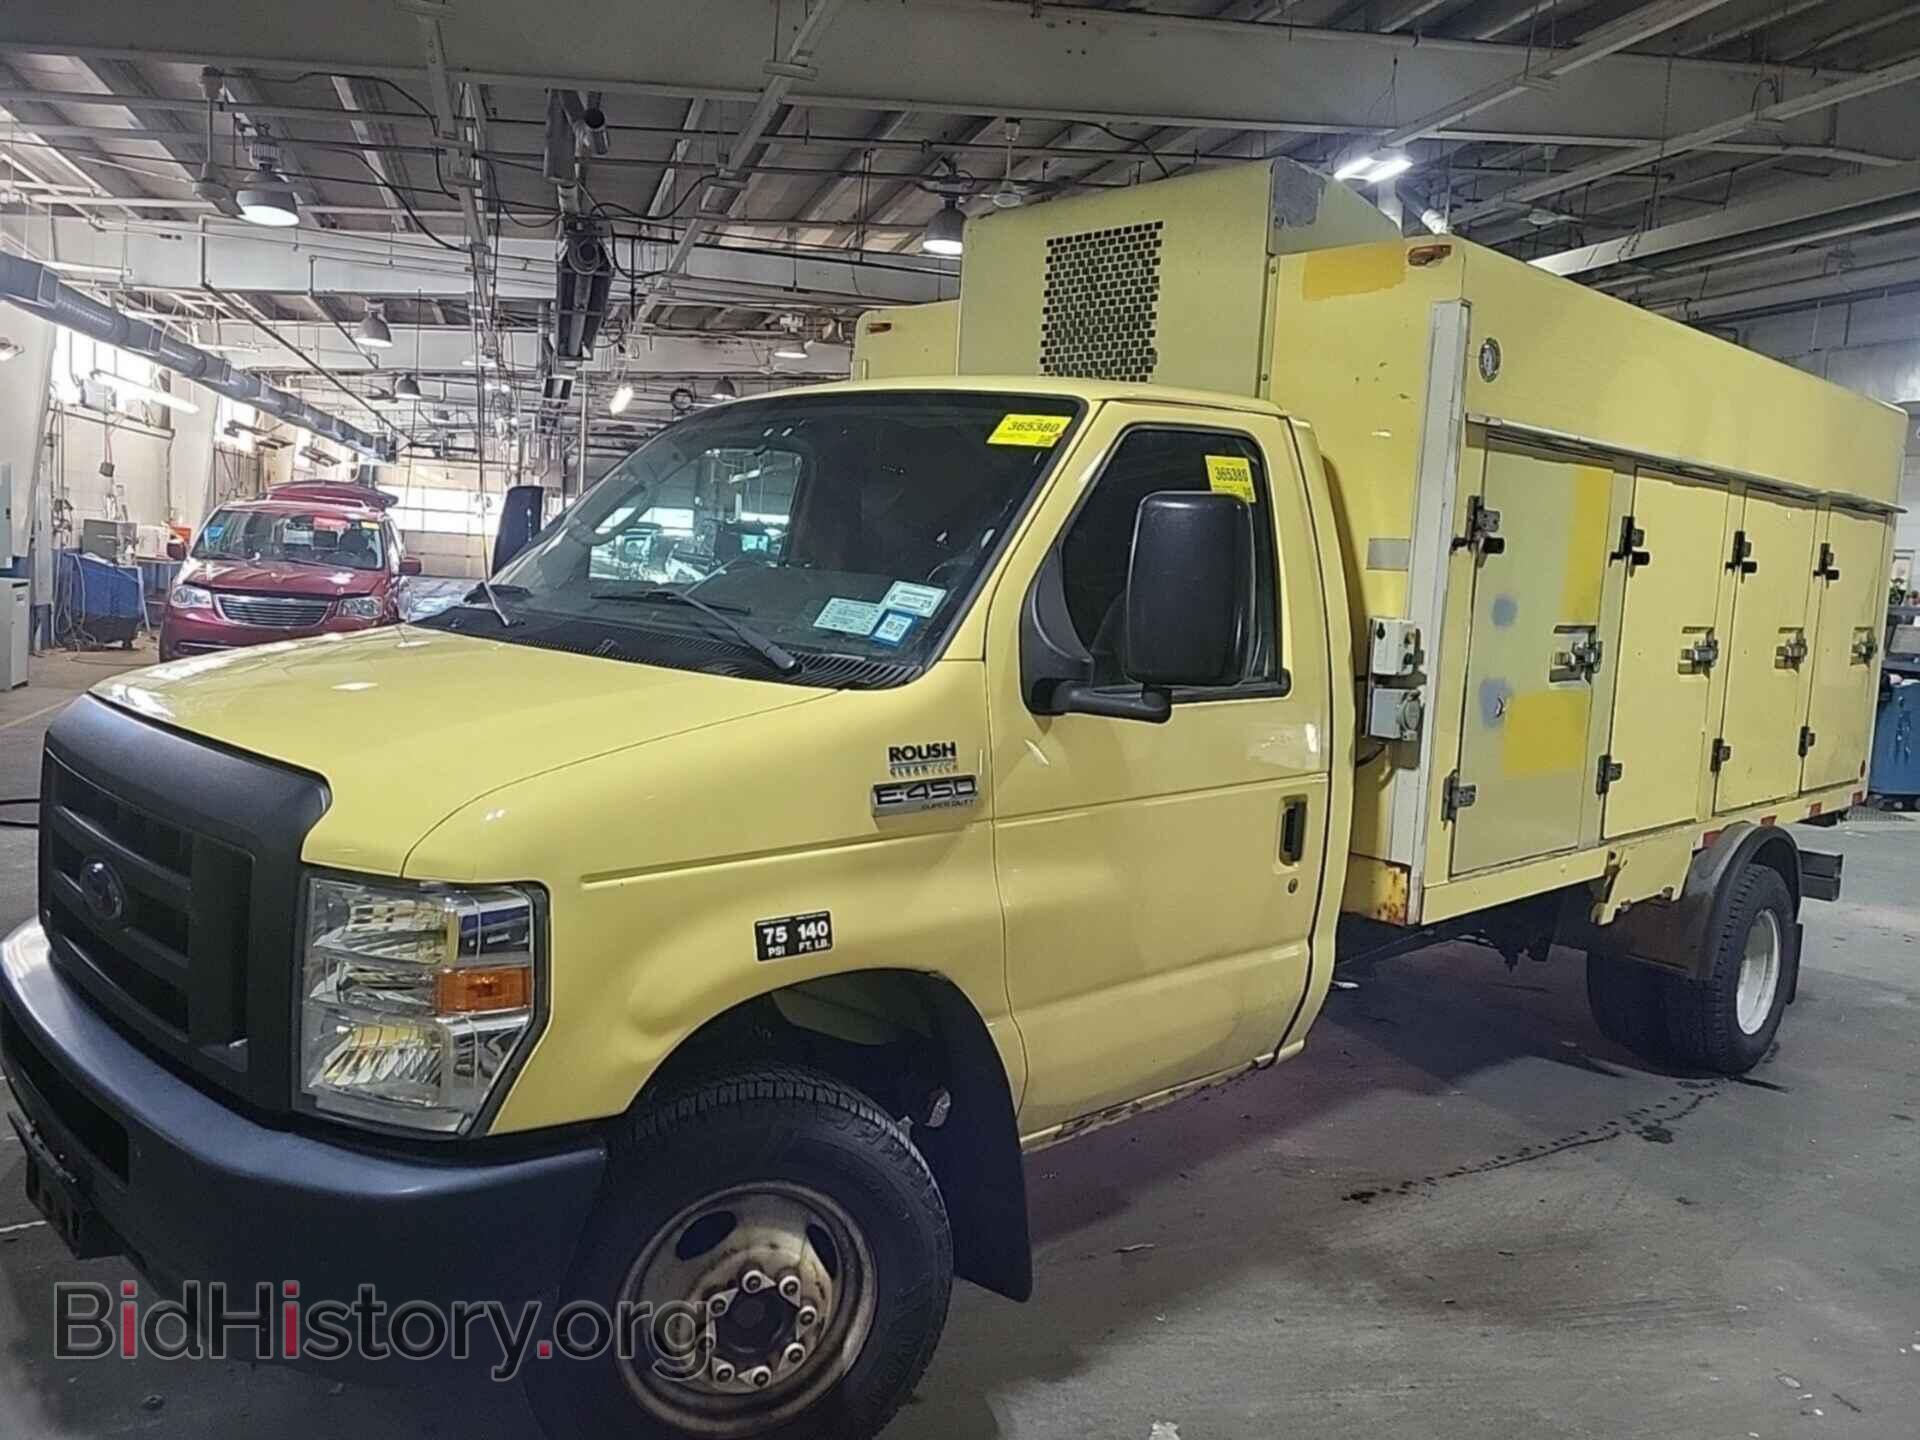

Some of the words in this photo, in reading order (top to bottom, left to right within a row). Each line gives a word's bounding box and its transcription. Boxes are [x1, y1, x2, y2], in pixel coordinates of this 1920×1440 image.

[888, 742, 957, 763] ROUSH
[763, 925, 788, 945] 75
[798, 921, 829, 940] 140
[768, 945, 786, 957] PSI
